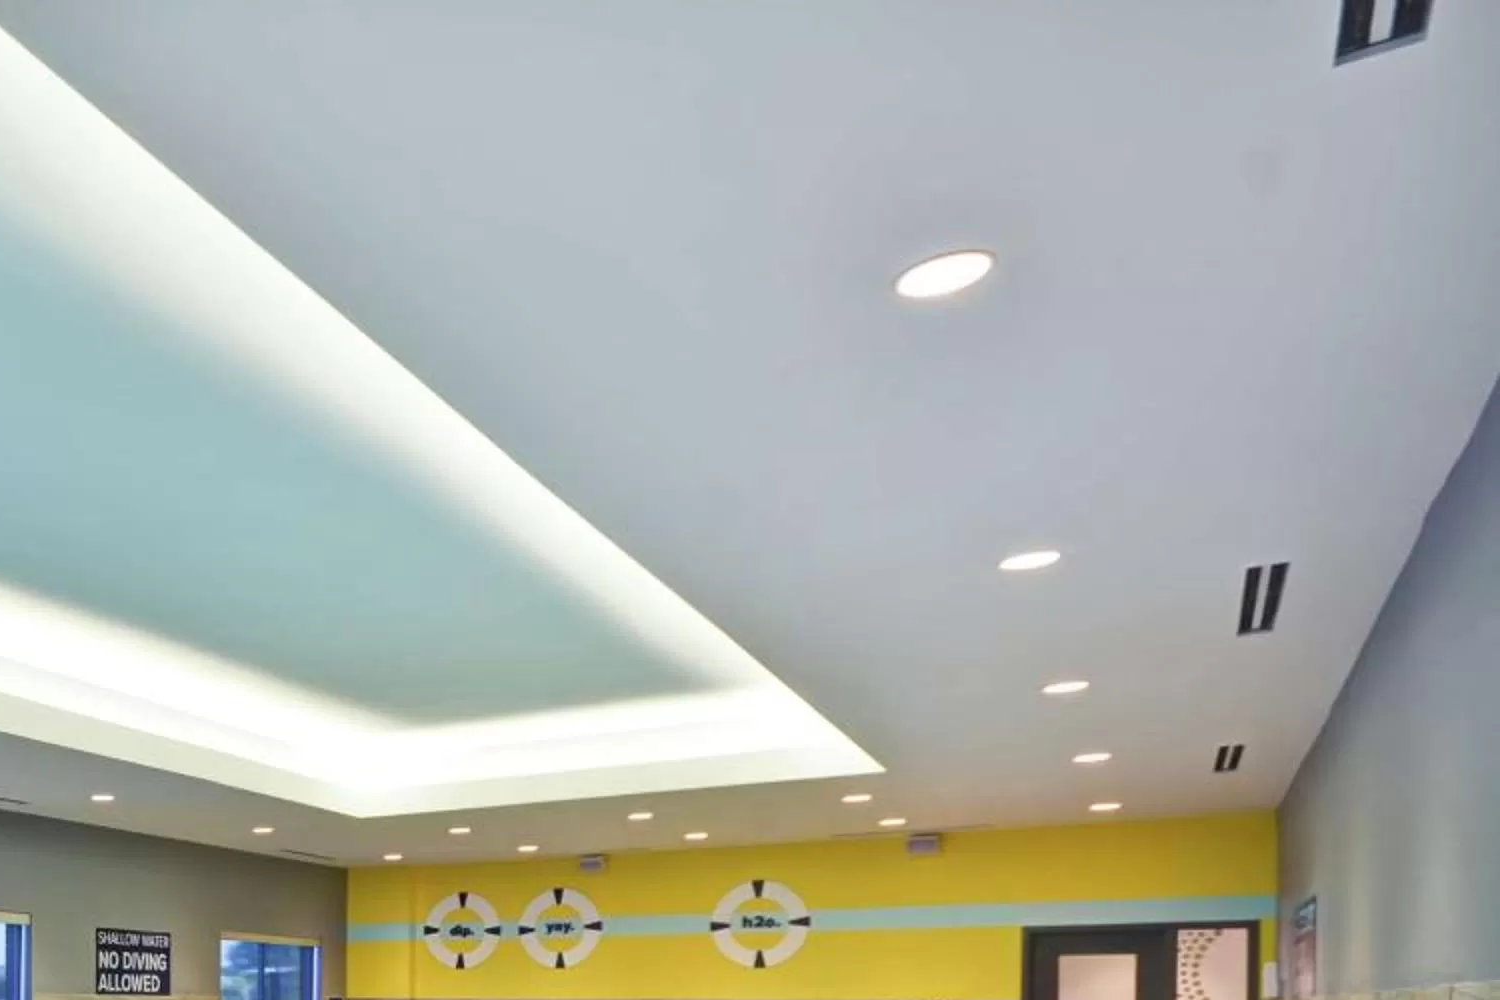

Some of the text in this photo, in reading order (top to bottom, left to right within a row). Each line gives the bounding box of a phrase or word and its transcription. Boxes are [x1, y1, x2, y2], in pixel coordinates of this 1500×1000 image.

[98, 931, 140, 946] SHALLOW
[99, 951, 167, 972] NO DIVING
[98, 974, 161, 992] ALLOWED
